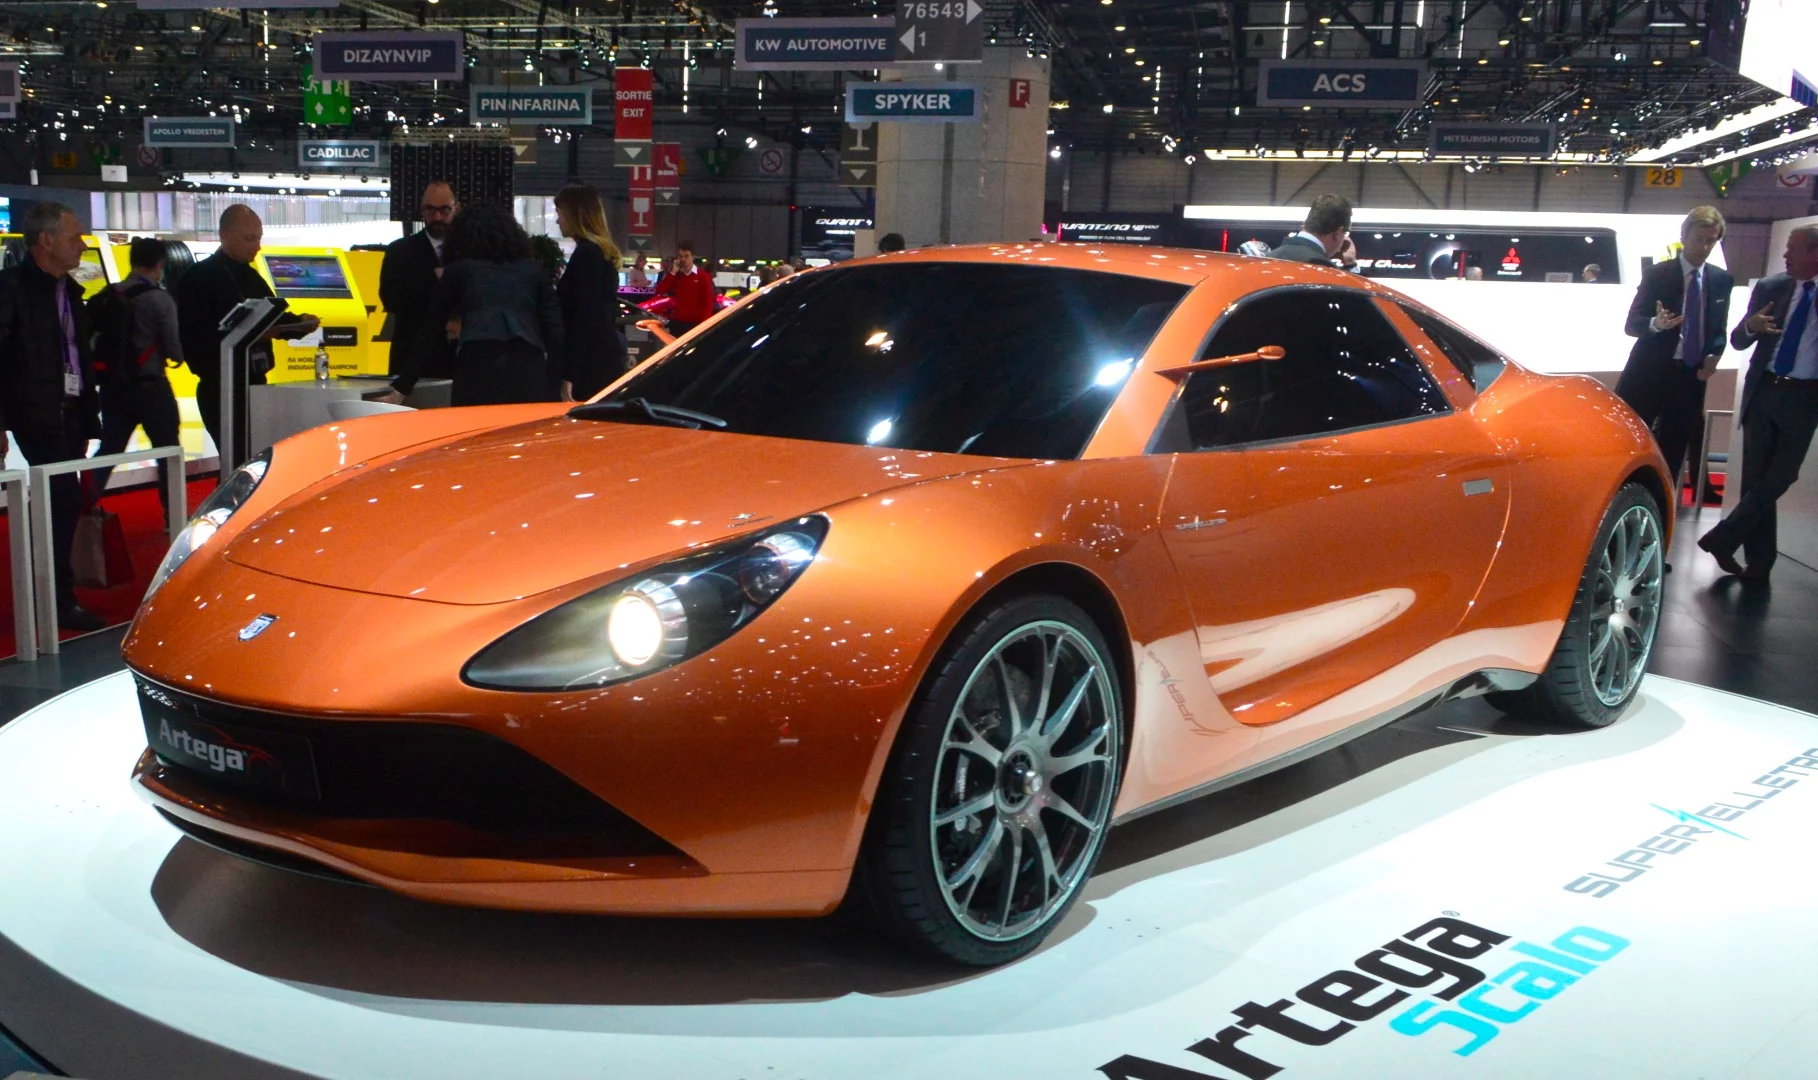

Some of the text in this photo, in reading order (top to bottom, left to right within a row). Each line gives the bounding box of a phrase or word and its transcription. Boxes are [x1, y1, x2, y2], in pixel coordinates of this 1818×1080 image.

[755, 38, 887, 51] KW AUTOMOTIVE
[918, 31, 927, 47] 1
[343, 49, 432, 64] DIZAYNVIP
[1312, 73, 1366, 93] ACS
[615, 91, 653, 100] SORTIE
[1016, 81, 1027, 101] F
[480, 98, 581, 112] PININFARINA
[874, 93, 951, 110] SPYKER
[622, 108, 645, 118] EXIT
[183, 128, 226, 136] VREDESTEIN
[1443, 135, 1541, 144] MITSUBISHI MOTORS
[307, 147, 370, 159] CADILLAC
[1651, 169, 1676, 186] 28
[158, 717, 244, 772] Artega
[1388, 925, 1632, 1058] Scalo
